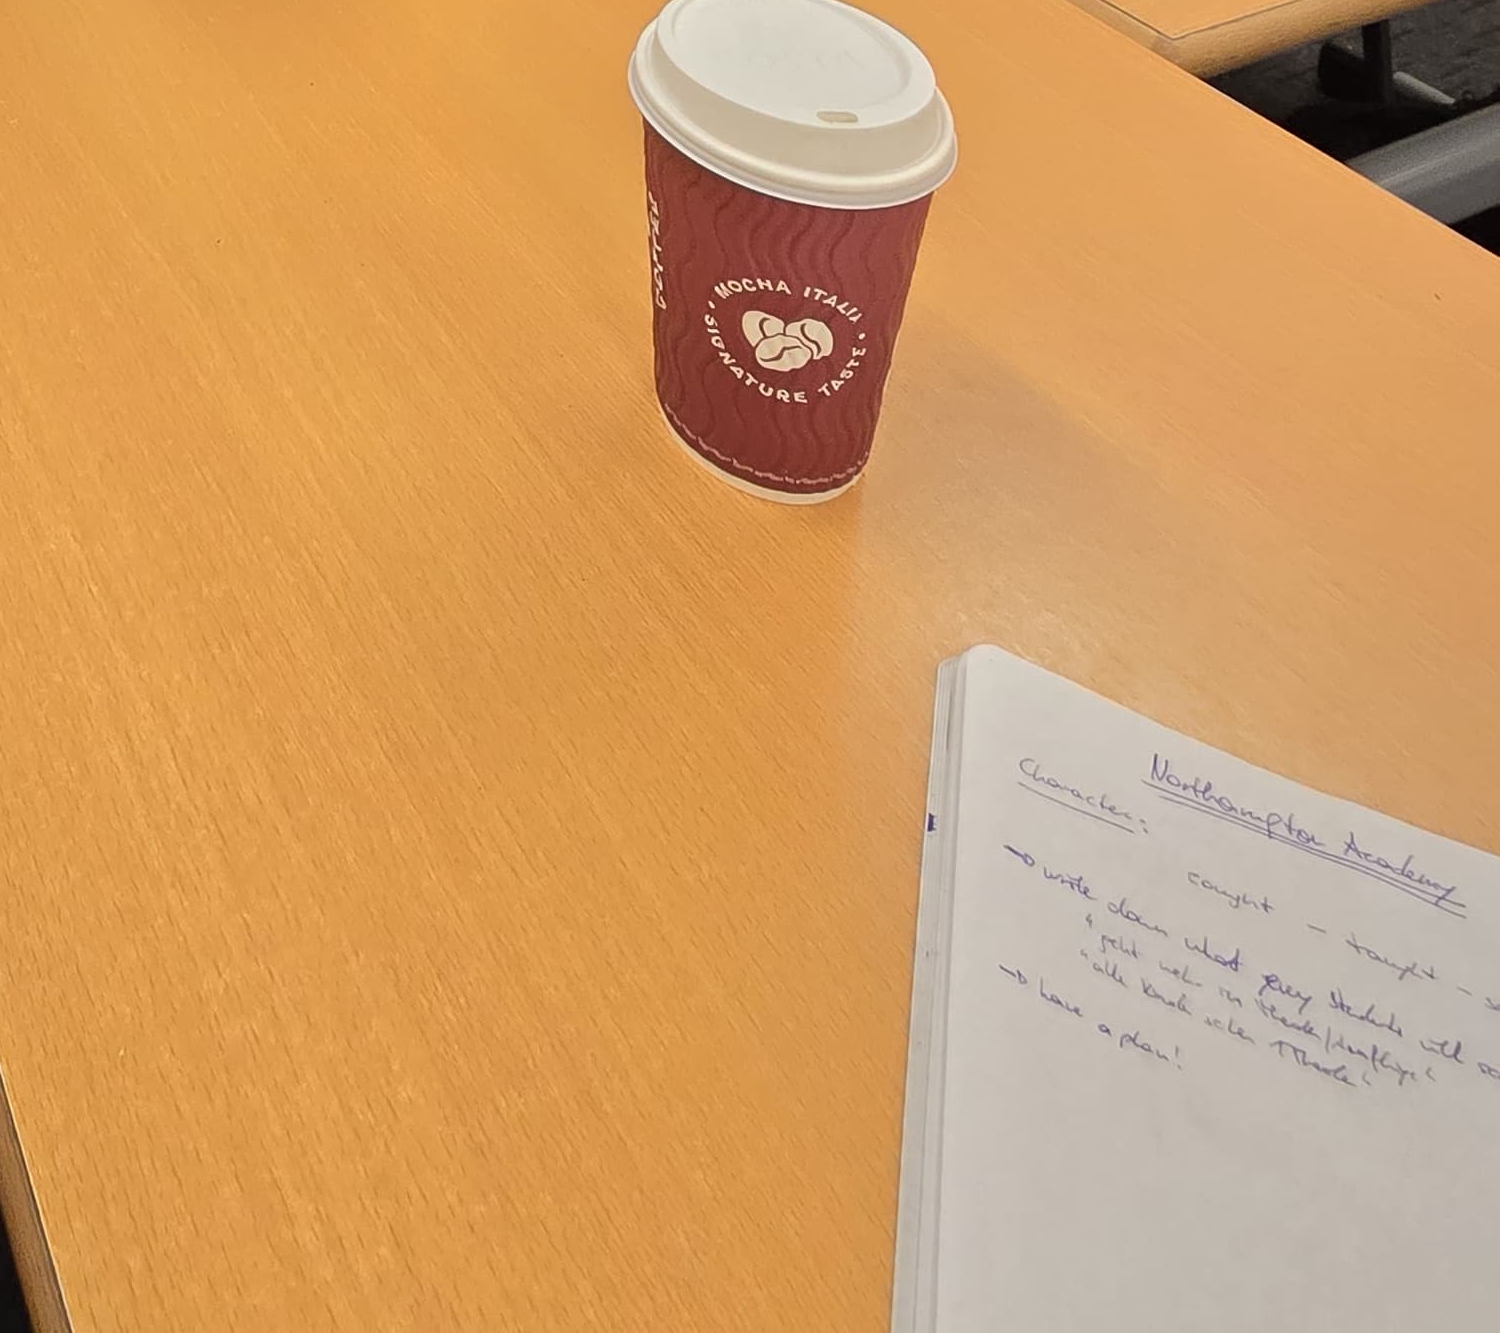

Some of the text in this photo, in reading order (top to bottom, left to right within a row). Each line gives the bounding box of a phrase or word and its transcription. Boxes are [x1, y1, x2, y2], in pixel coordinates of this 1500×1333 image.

[714, 278, 864, 324] MOCHA ITALIA
[704, 314, 868, 404] SIGNATURE TASTE
